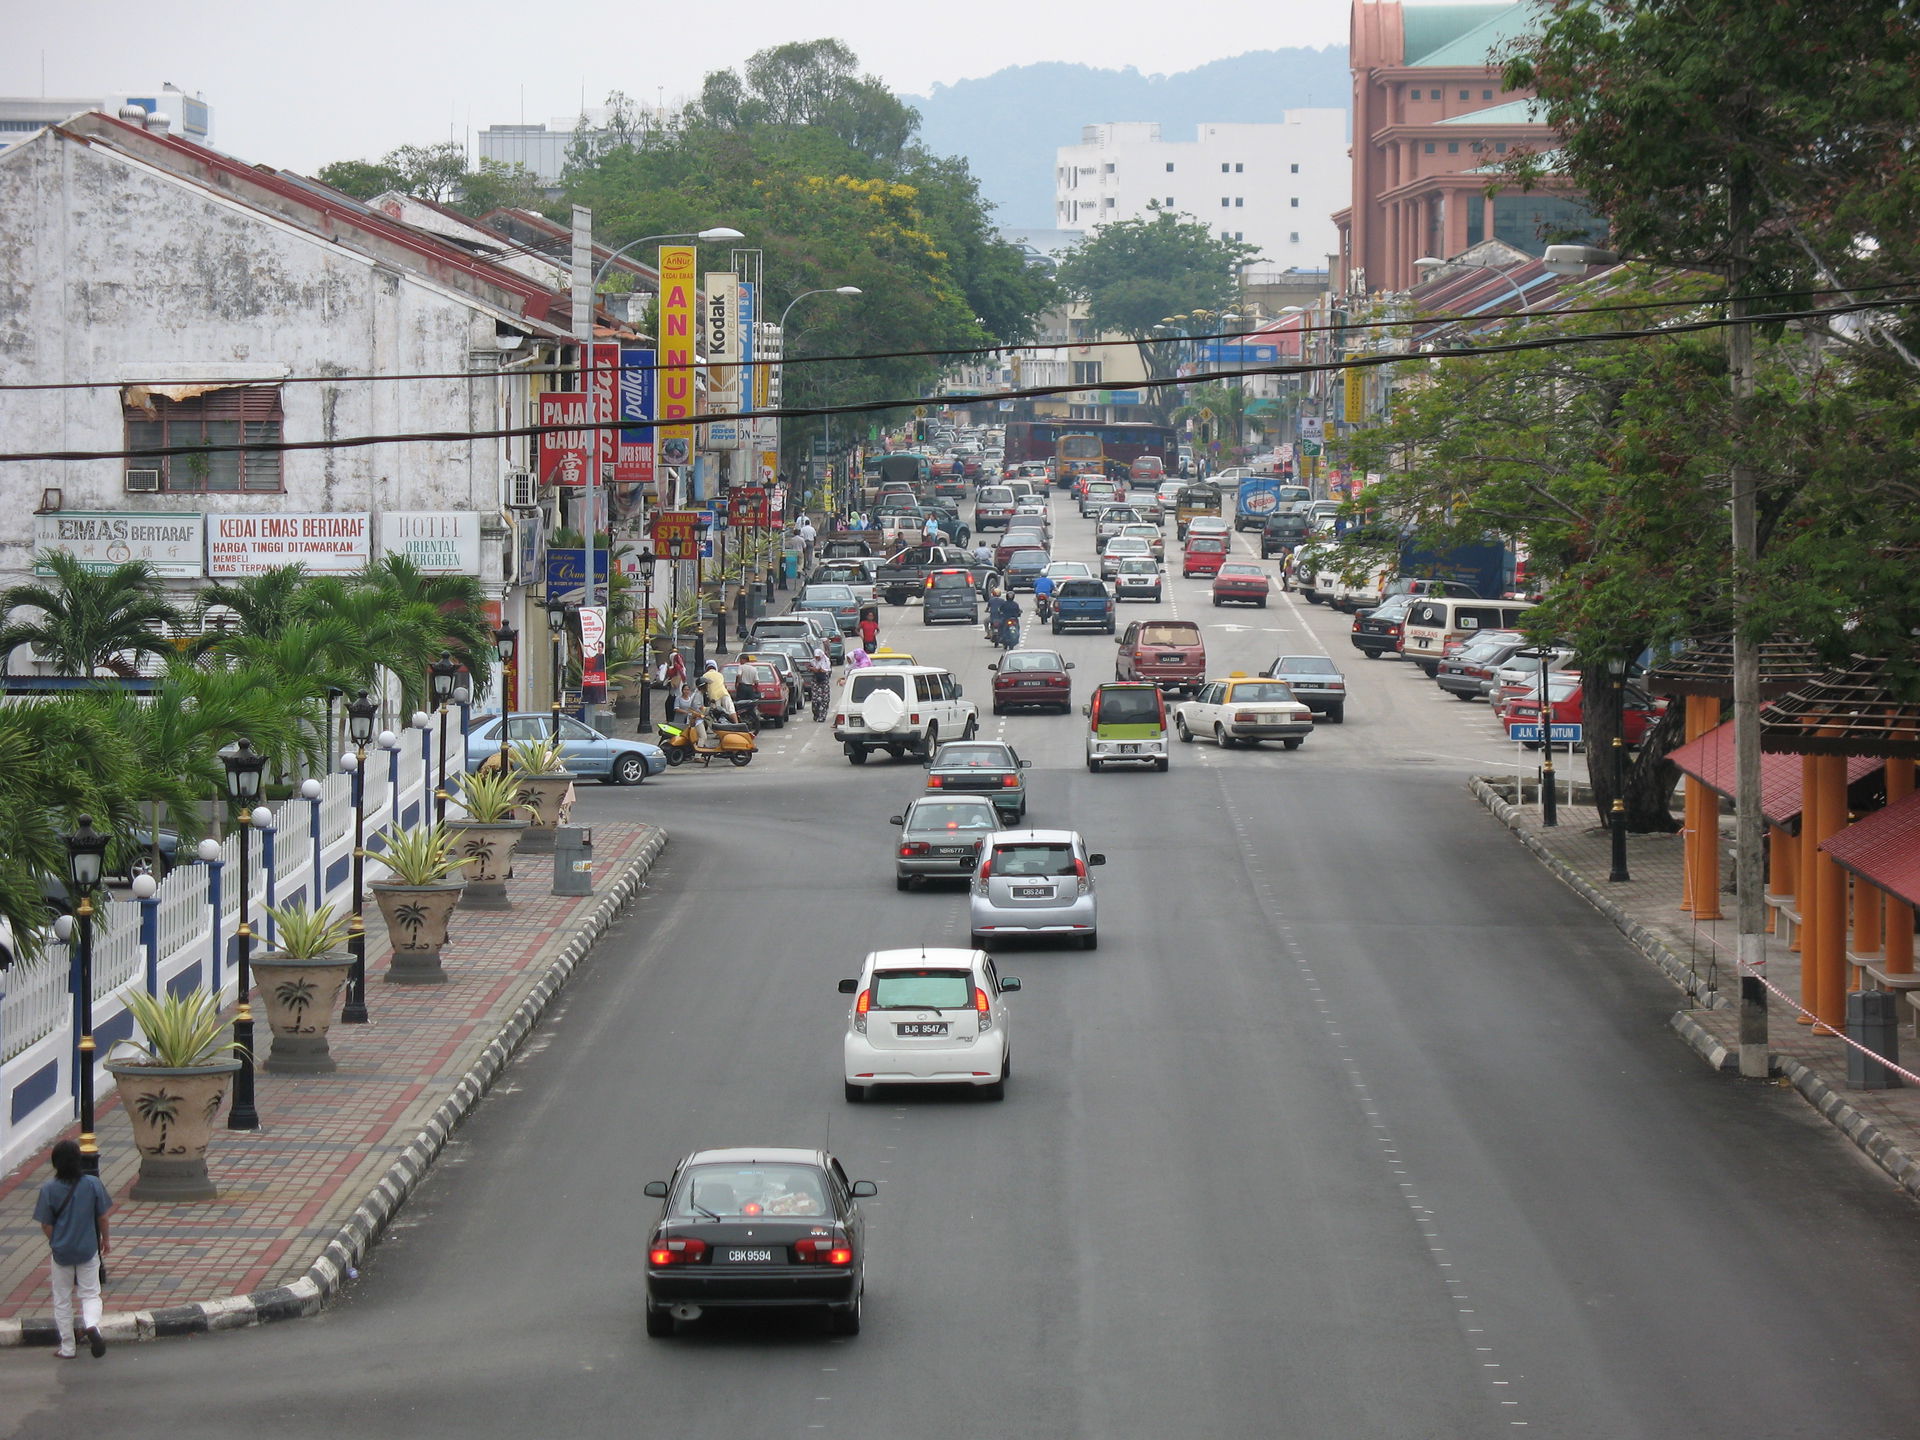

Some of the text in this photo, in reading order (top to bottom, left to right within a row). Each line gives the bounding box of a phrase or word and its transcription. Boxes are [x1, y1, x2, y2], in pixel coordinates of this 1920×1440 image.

[709, 293, 726, 355] Kodak
[559, 451, 583, 482] 當
[58, 519, 128, 541] EMAS
[131, 525, 195, 542] BERTARAF
[220, 518, 365, 538] KEDAI EMAS BERTARAF
[398, 516, 464, 538] HOTEL
[213, 541, 353, 553] HARGA TINGGI DITAWARKAN
[405, 540, 457, 553] ORIENTAL
[655, 541, 693, 556] AU
[213, 554, 249, 563] MEMBELI
[213, 564, 236, 572] EMAS
[1518, 727, 1574, 738] JLN. TEUNTUM
[905, 1025, 919, 1034] BJG
[728, 1250, 771, 1262] CBK9594
